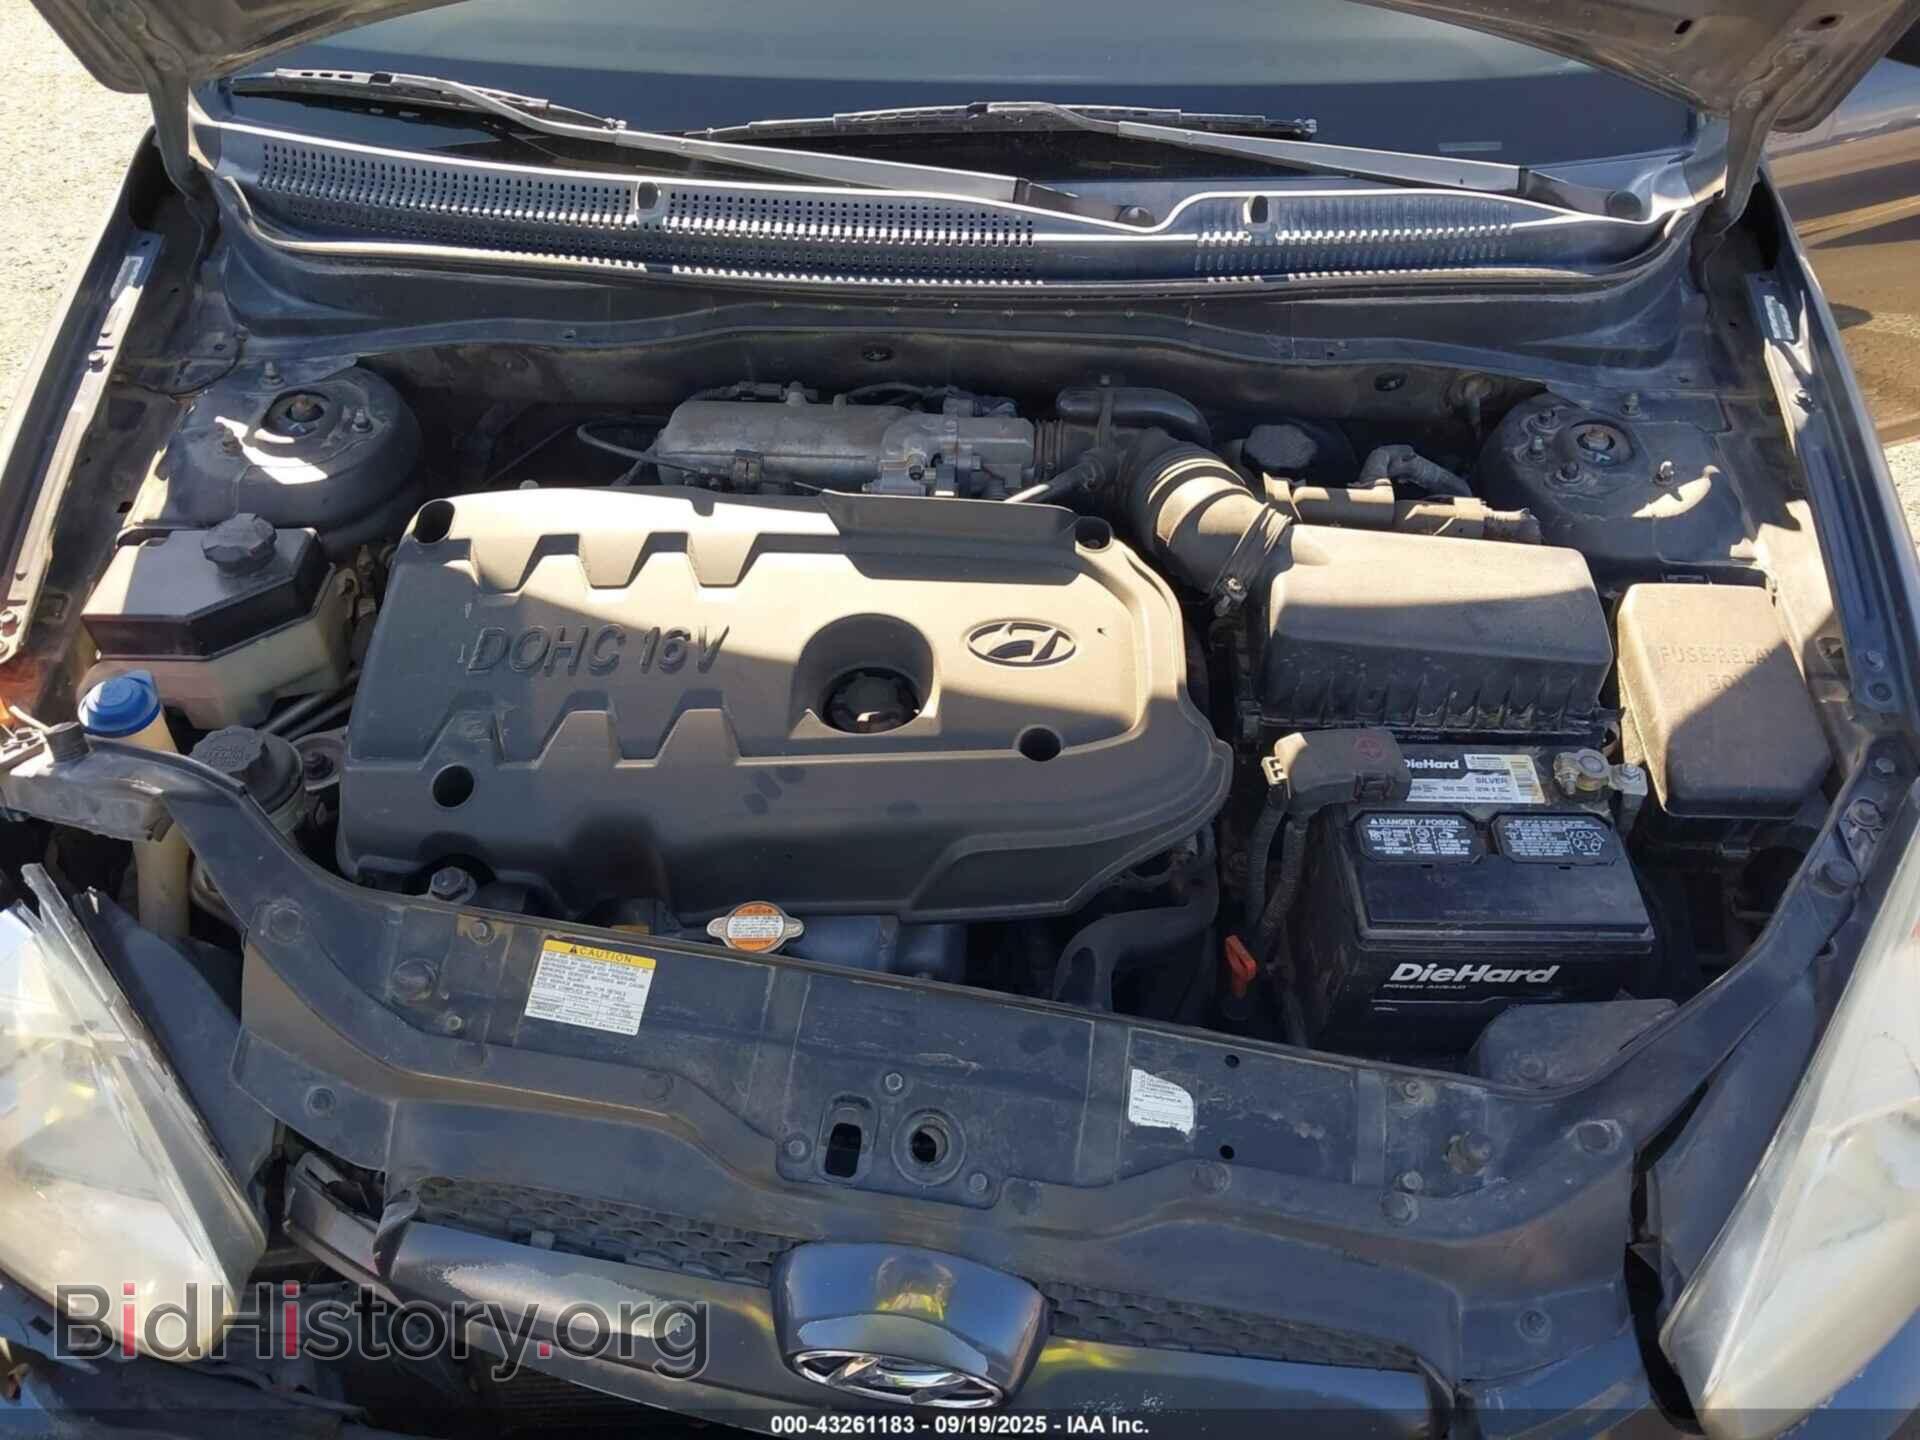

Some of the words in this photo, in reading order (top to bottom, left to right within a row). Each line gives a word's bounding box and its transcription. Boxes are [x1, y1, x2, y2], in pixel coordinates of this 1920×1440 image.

[467, 623, 626, 676] DOHC
[639, 623, 730, 674] 16V
[1475, 776, 1507, 785] SILVER
[1379, 818, 1416, 826] DANGER
[1425, 818, 1459, 827] POISON
[579, 947, 632, 963] CAUTION
[1390, 963, 1560, 983] DieHard
